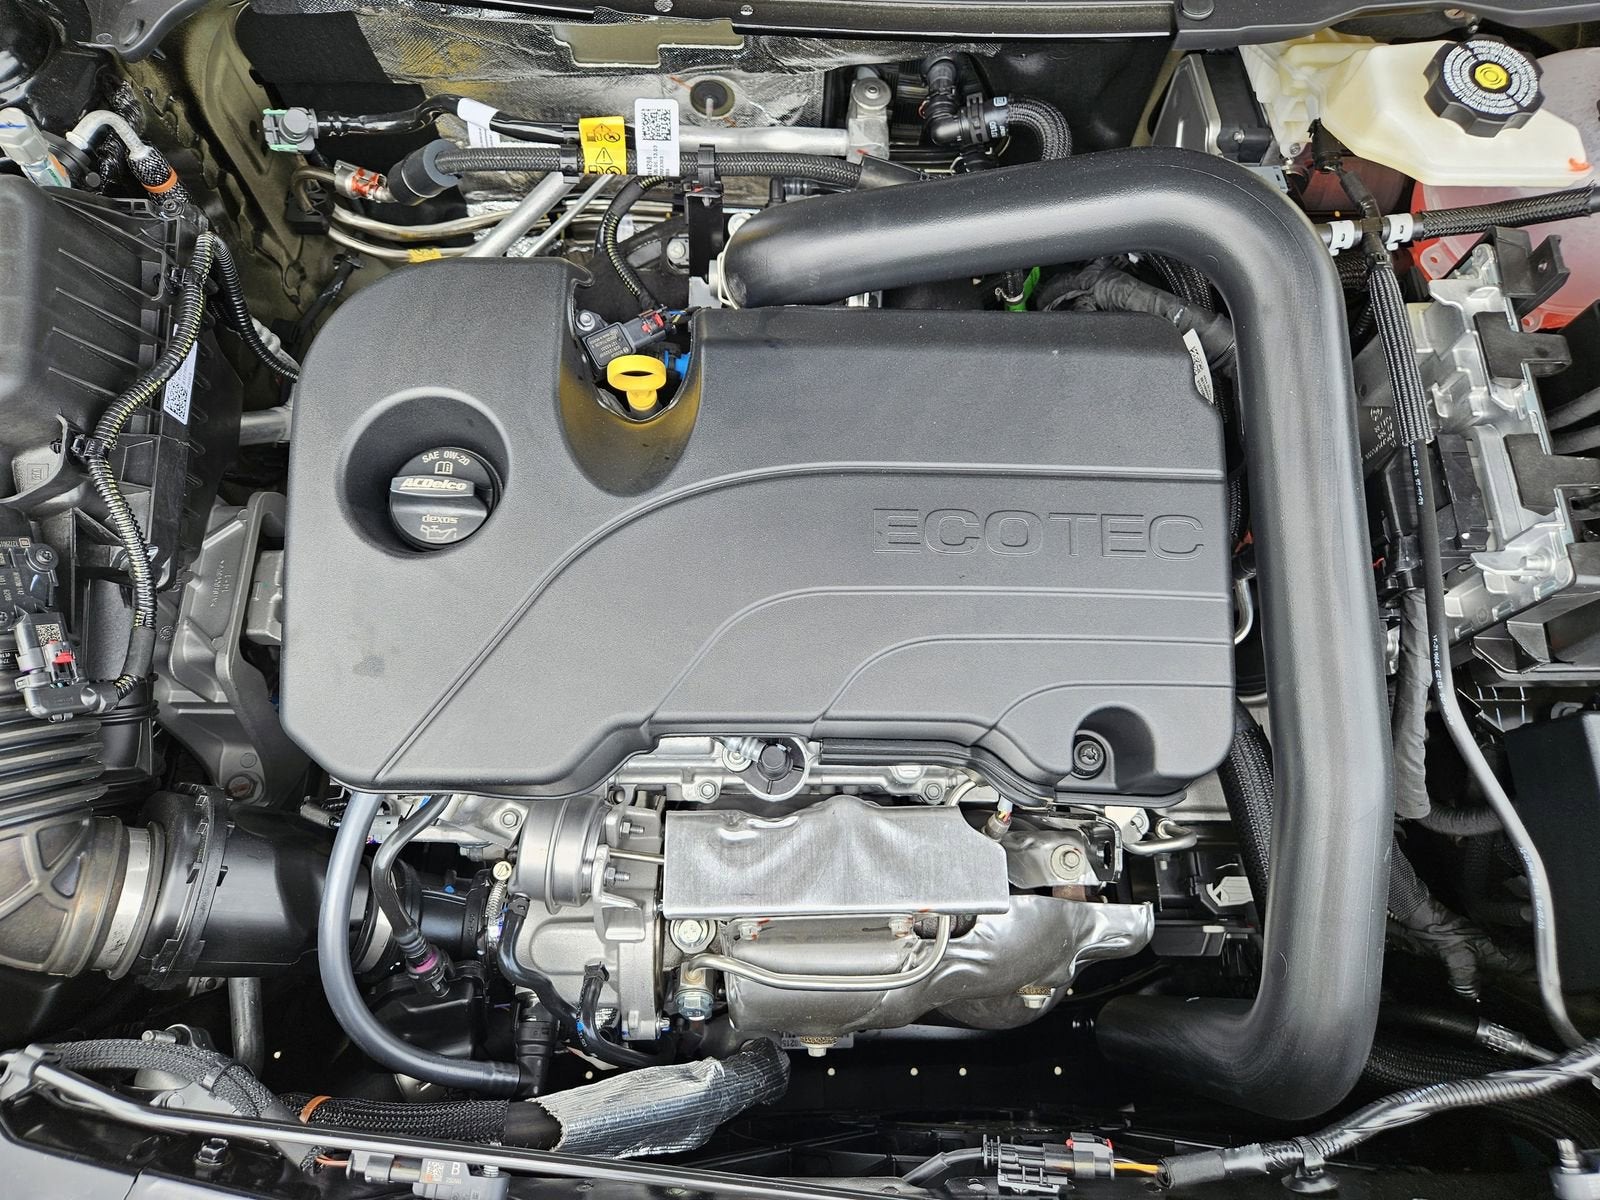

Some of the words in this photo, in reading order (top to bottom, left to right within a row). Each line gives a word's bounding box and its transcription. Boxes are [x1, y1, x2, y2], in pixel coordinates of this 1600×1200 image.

[422, 451, 439, 463] SAE
[443, 450, 470, 466] 0W-20
[400, 478, 467, 490] ACDelco
[422, 514, 459, 524] dexos
[873, 507, 1204, 561] ECOTEC
[451, 1162, 460, 1175] B
